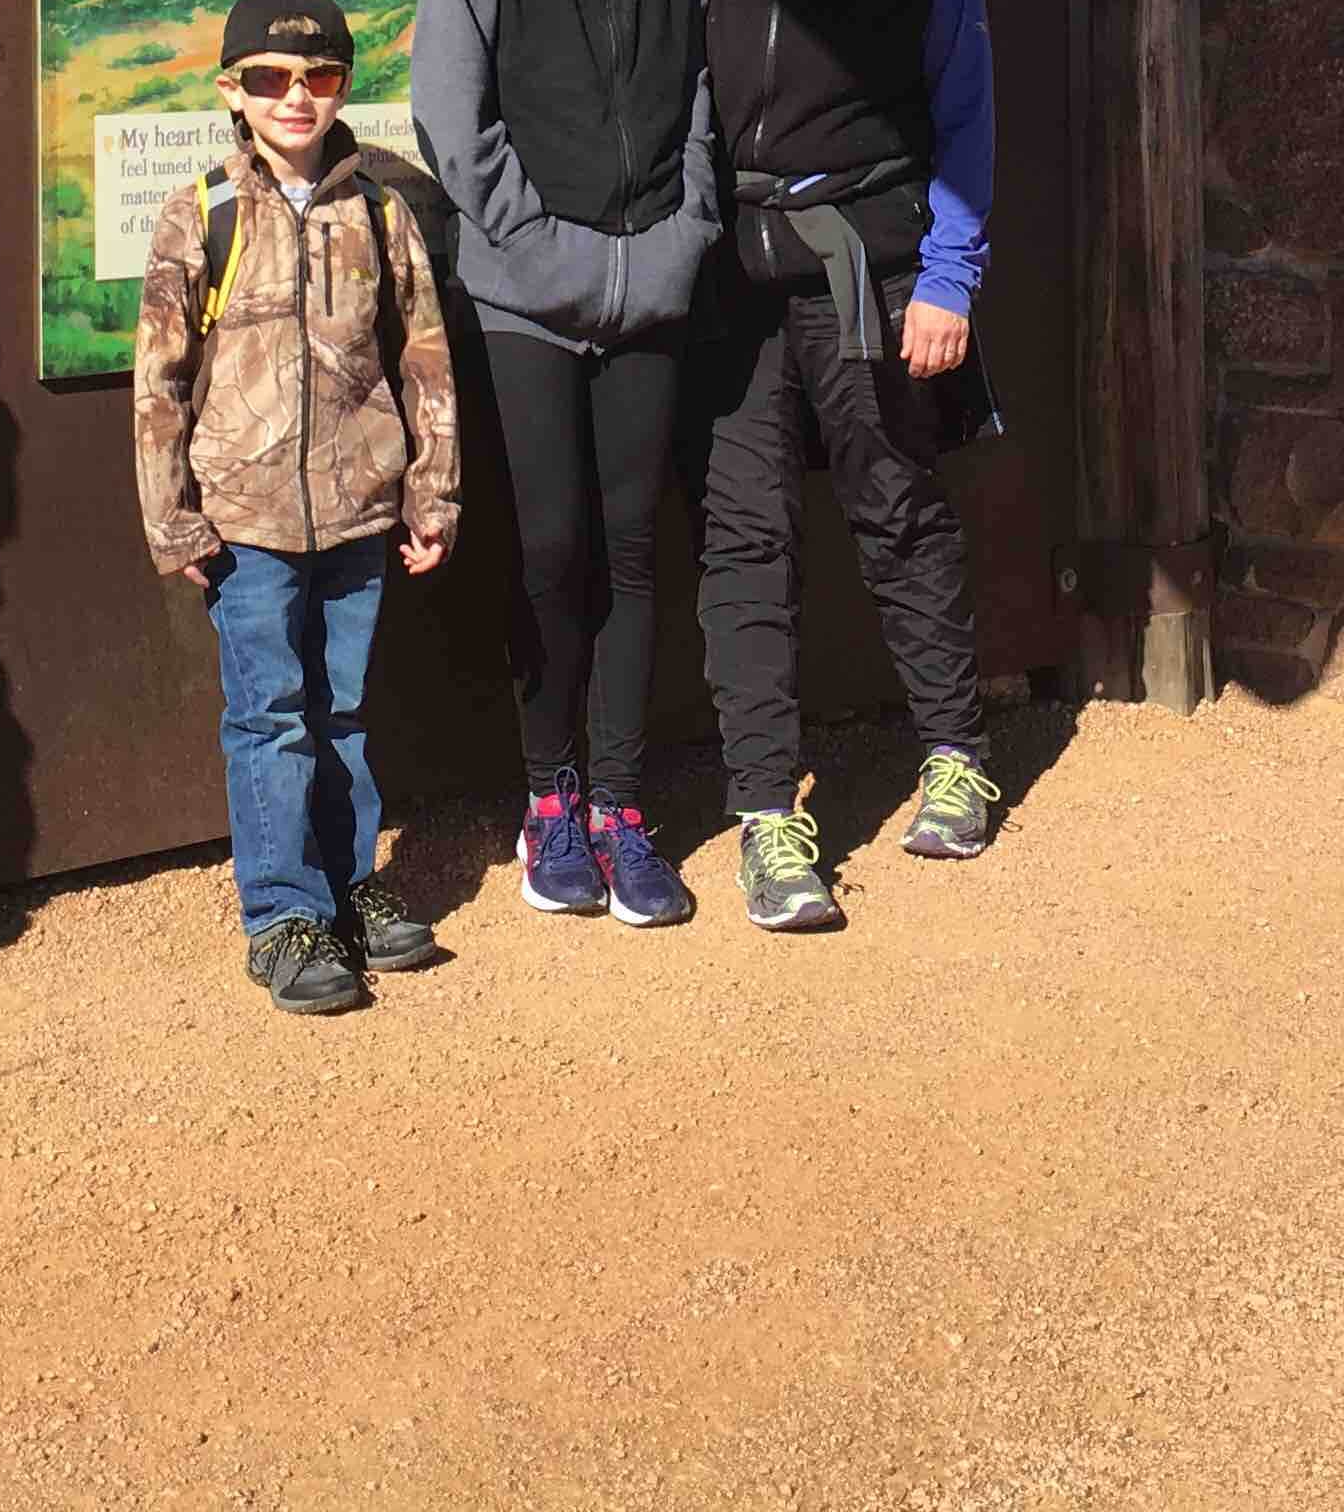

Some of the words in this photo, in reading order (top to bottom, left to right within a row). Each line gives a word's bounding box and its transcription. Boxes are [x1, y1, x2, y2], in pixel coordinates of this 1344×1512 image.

[120, 126, 149, 154] My
[153, 123, 201, 148] heart
[206, 121, 234, 146] fee
[120, 158, 148, 178] feel
[153, 155, 193, 177] tuned
[403, 148, 424, 163] roc
[120, 188, 169, 207] matter
[120, 215, 137, 234] of
[140, 215, 156, 233] th
